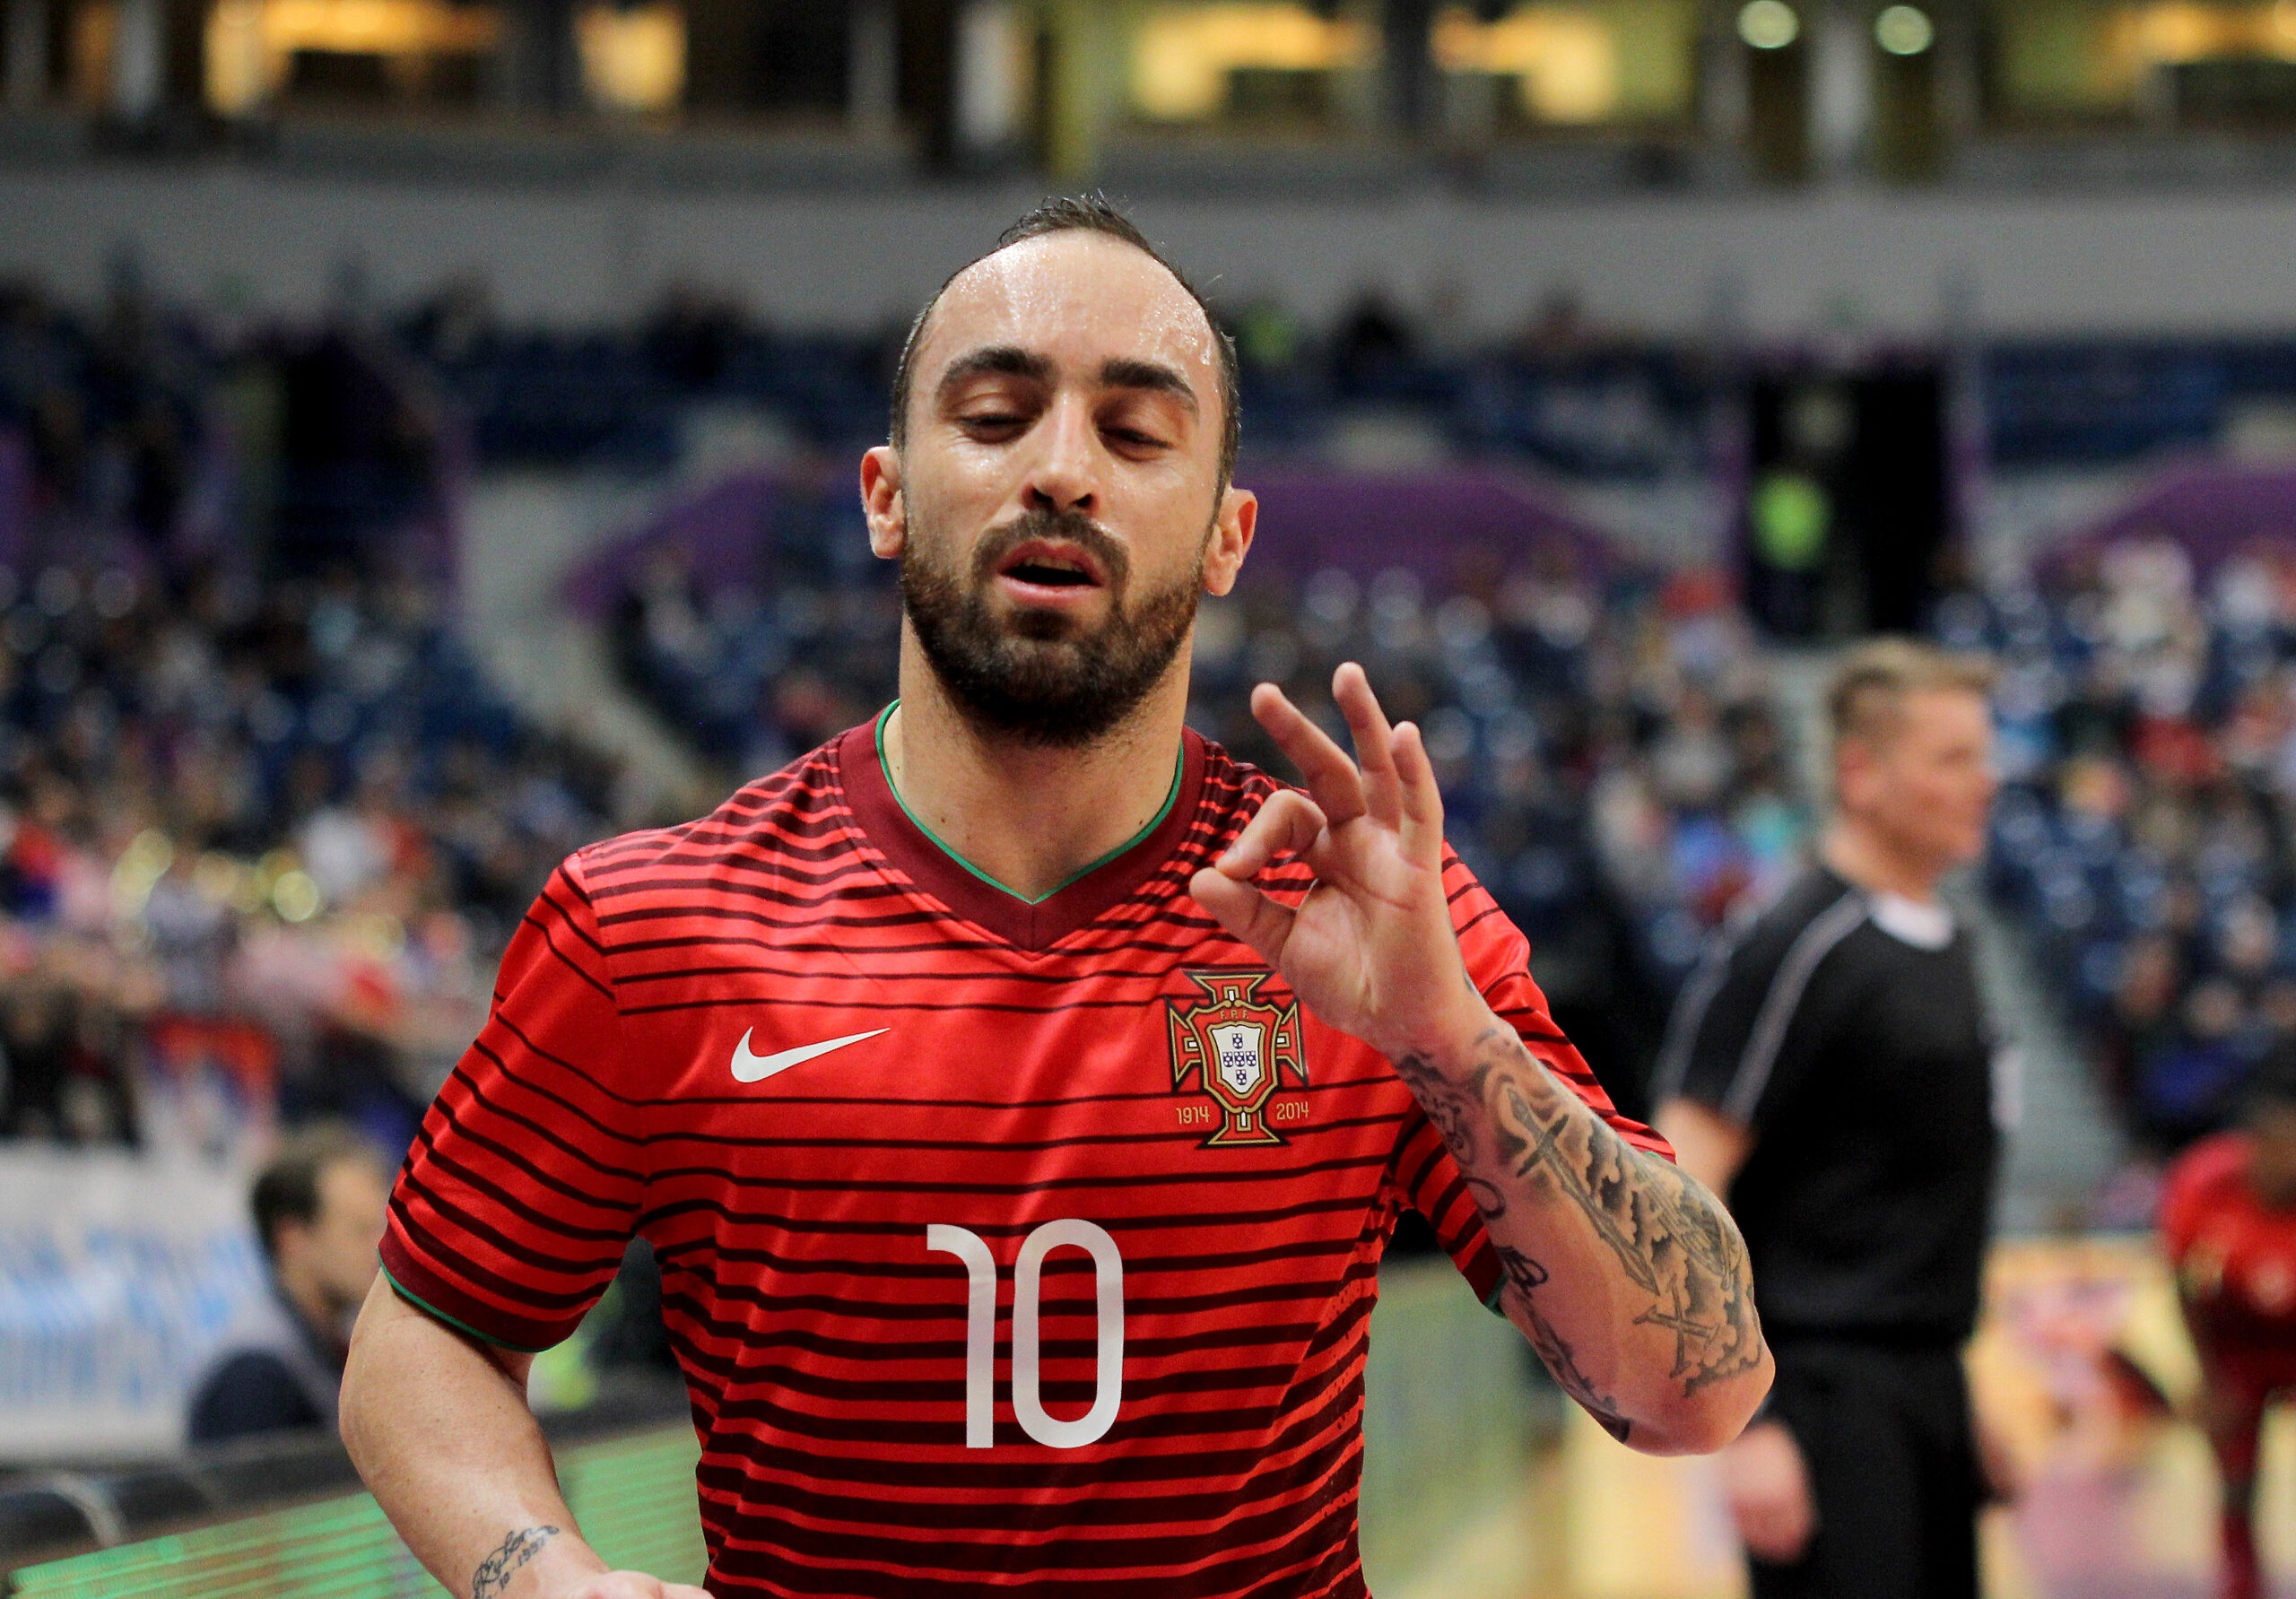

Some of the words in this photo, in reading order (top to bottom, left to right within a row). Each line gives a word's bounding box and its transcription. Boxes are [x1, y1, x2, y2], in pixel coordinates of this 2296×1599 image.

[1177, 1105, 1210, 1125] 1914
[1276, 1102, 1309, 1121] 2014
[926, 1218, 1125, 1449] 10
